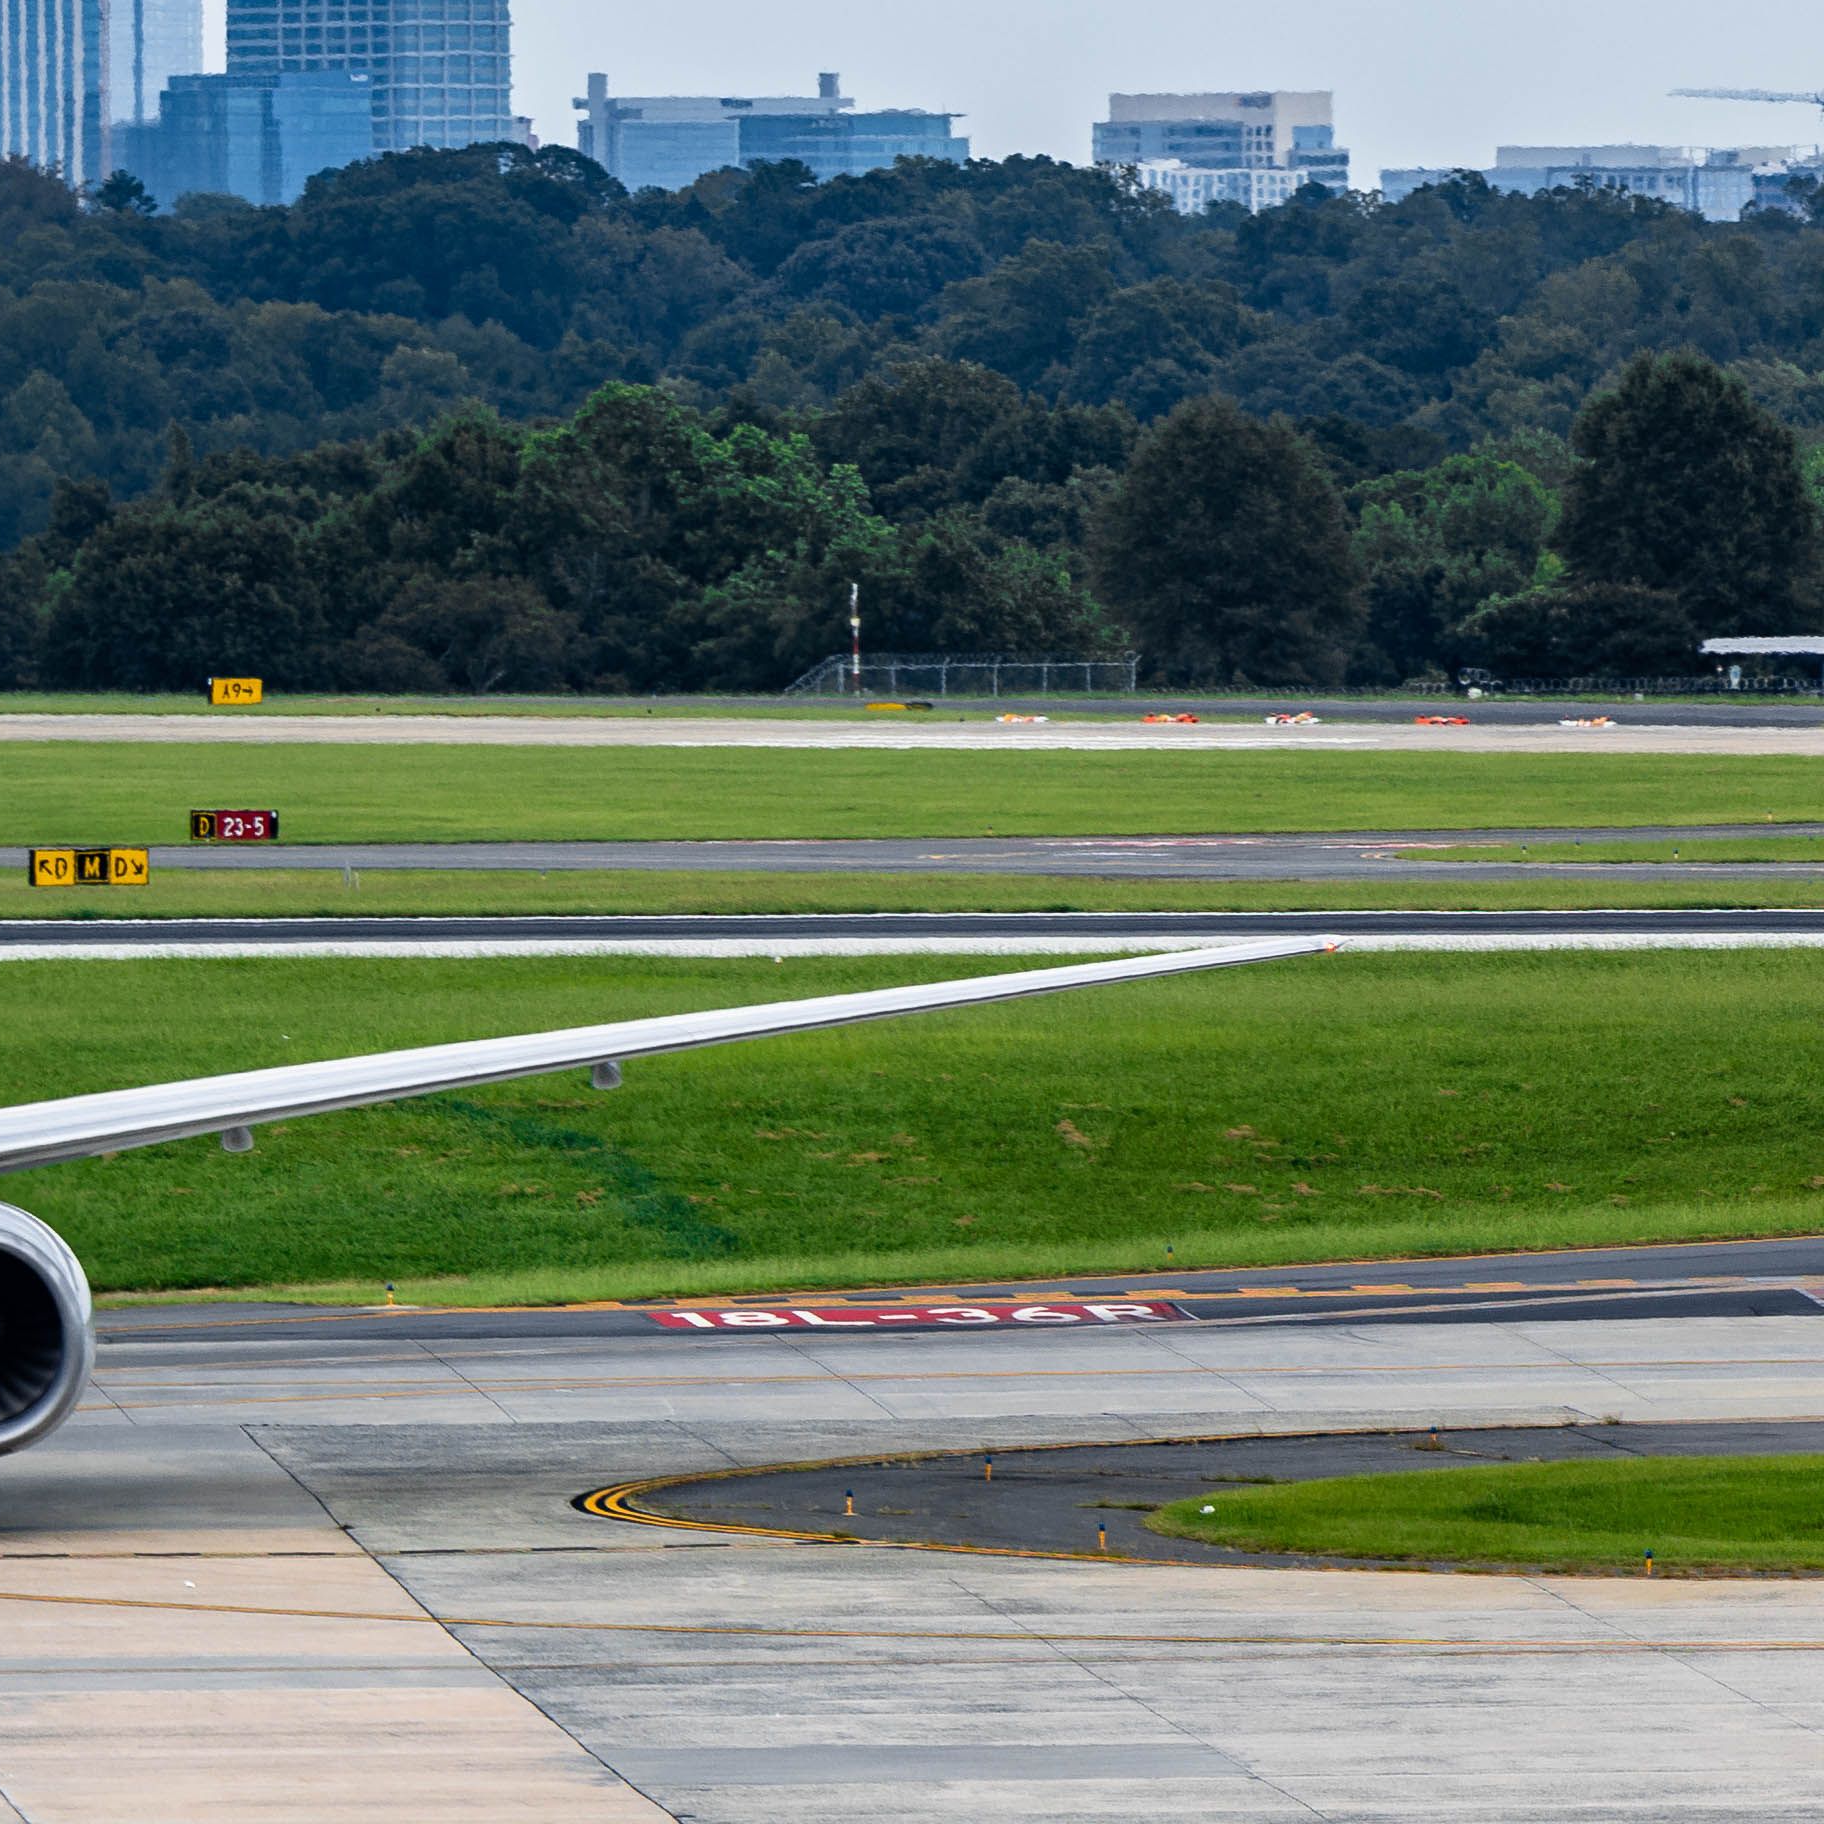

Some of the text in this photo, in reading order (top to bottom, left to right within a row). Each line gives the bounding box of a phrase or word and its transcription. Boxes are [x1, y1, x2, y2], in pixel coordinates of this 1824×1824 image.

[222, 683, 241, 699] A9
[199, 816, 264, 837] D 23-5
[54, 855, 128, 879] D M D
[671, 1303, 1167, 1328] 18L-36R
